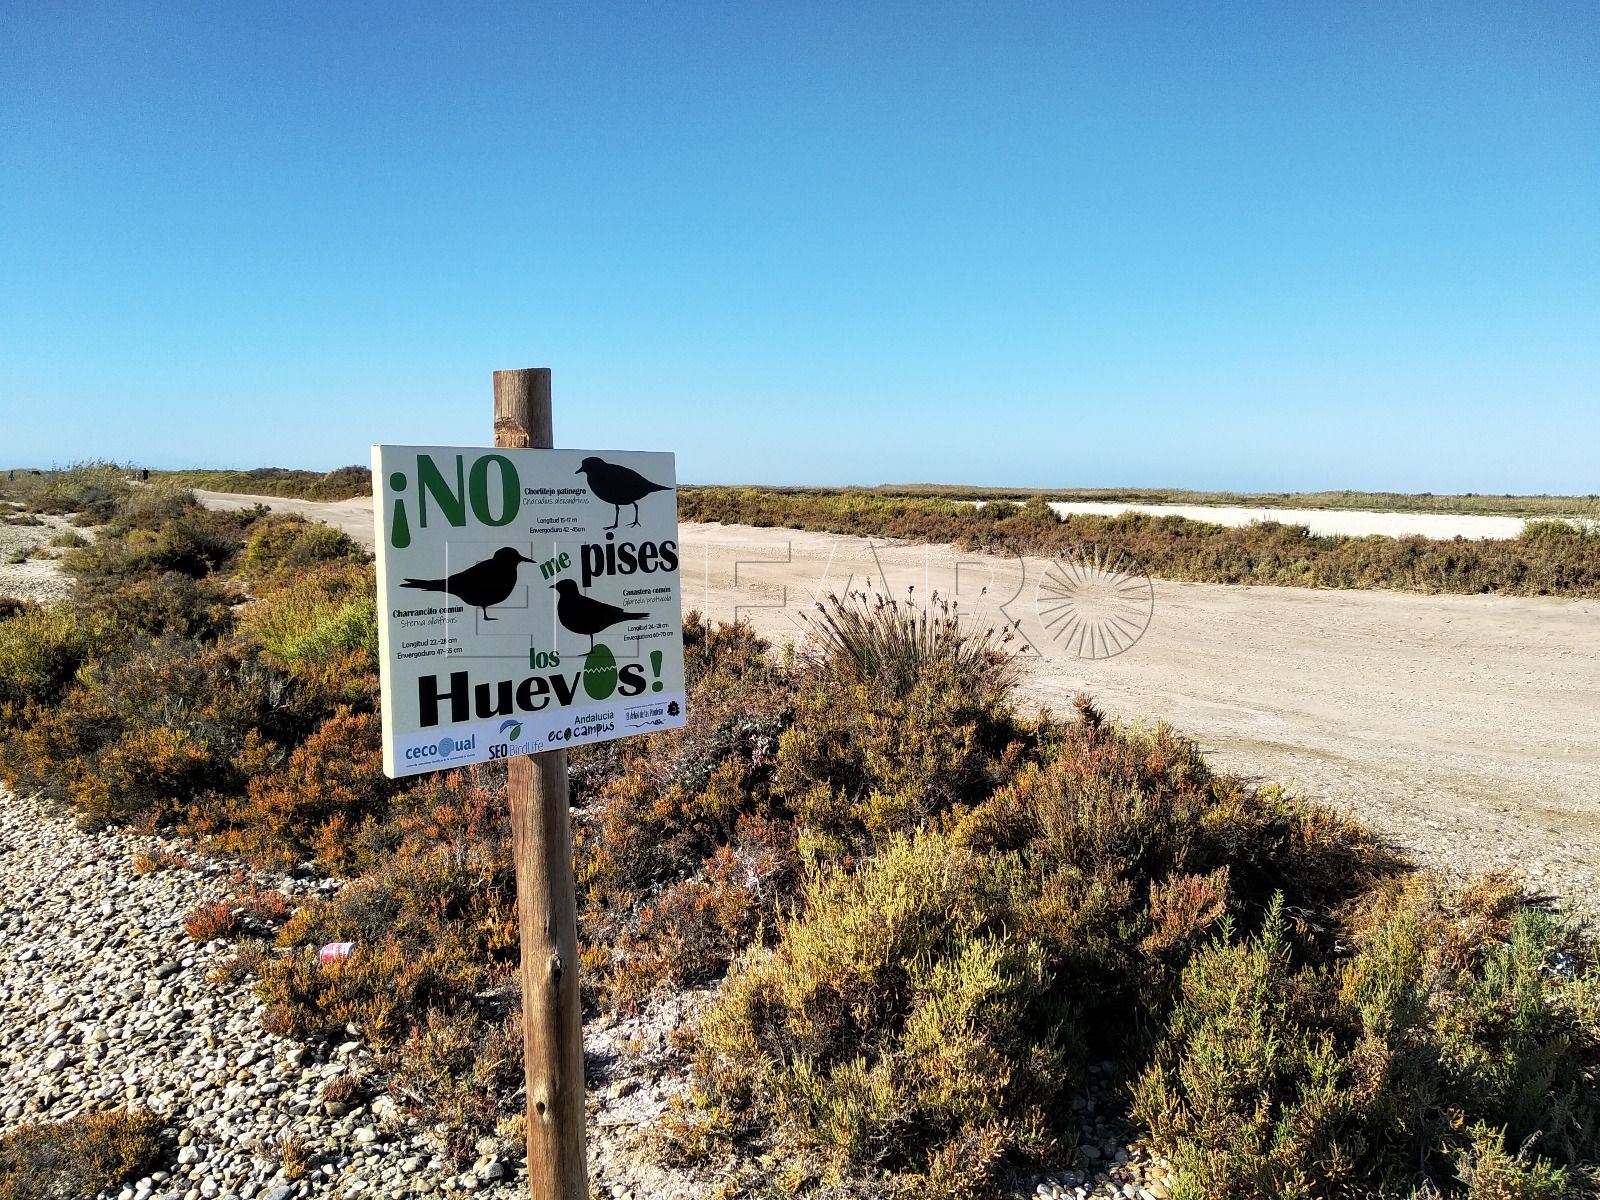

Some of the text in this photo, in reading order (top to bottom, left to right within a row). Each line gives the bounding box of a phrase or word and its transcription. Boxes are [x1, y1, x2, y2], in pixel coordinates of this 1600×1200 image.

[389, 454, 521, 549] ¡NO
[557, 487, 587, 497] patinegro
[539, 551, 572, 580] me
[580, 531, 679, 588] pises
[392, 604, 464, 618] Charrancito común
[401, 639, 429, 649] Longitud
[396, 650, 436, 660] Envergadura
[529, 647, 561, 670] los
[488, 739, 544, 760] SEO BirdLife
